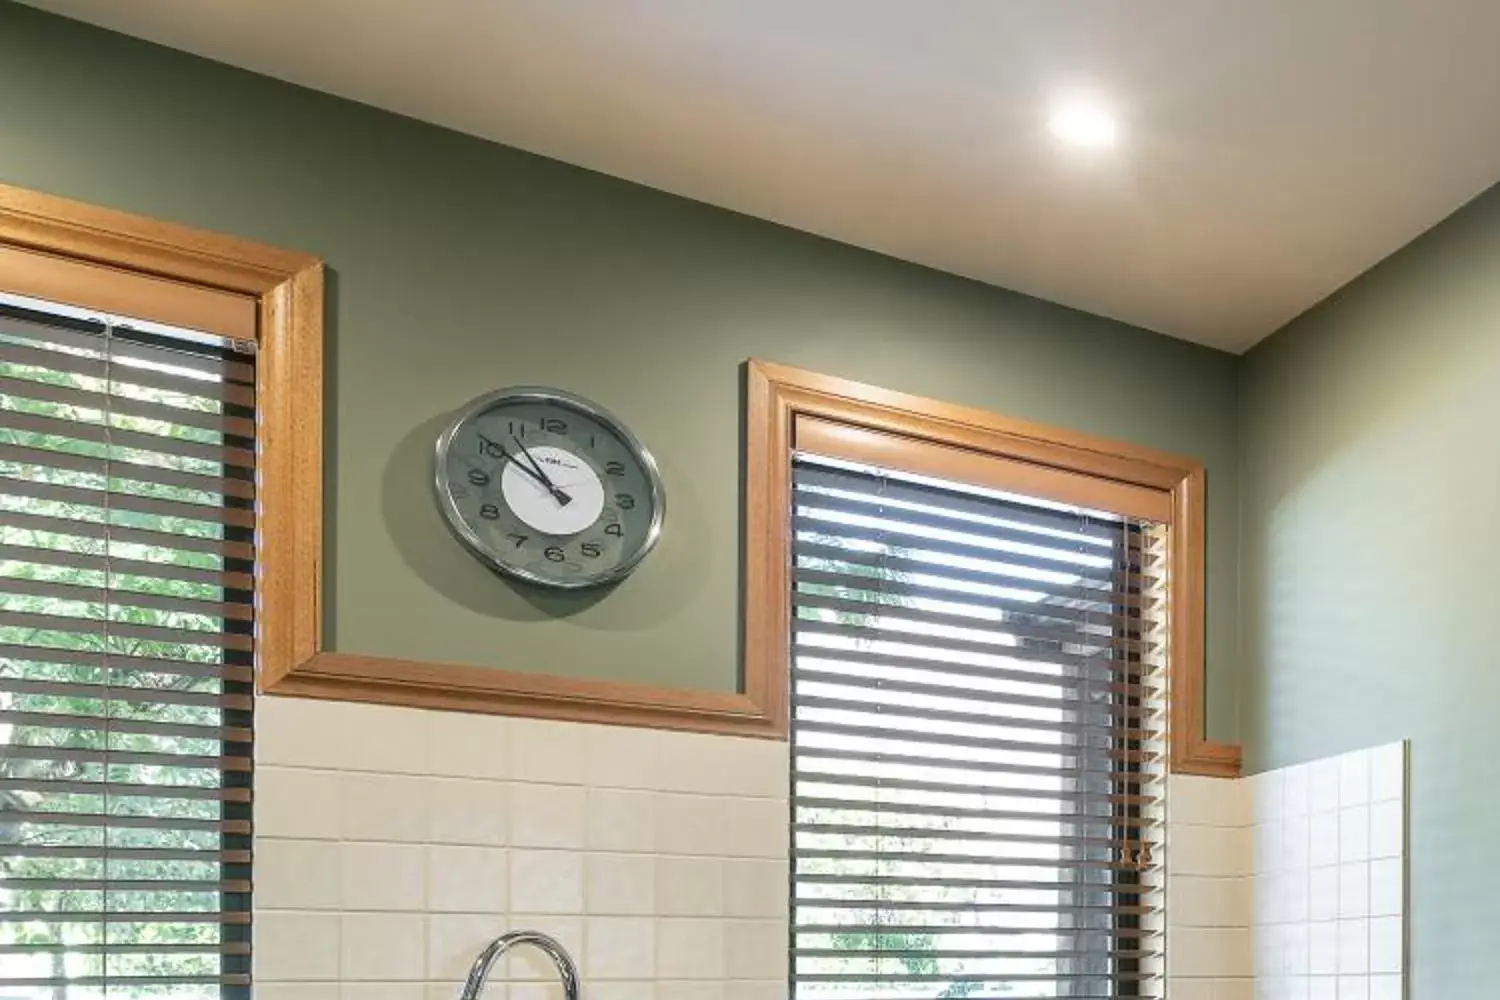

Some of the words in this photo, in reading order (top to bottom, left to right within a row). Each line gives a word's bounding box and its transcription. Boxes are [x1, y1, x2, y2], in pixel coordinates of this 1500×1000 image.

[508, 421, 525, 438] 11
[539, 418, 568, 435] 12
[478, 440, 505, 459] 10
[468, 469, 490, 486] 9
[605, 461, 625, 477] 2
[615, 493, 635, 510] 3
[479, 504, 500, 521] 8
[604, 523, 624, 538] 4
[507, 532, 529, 549] 7
[543, 546, 566, 562] 6
[581, 542, 602, 558] 5
